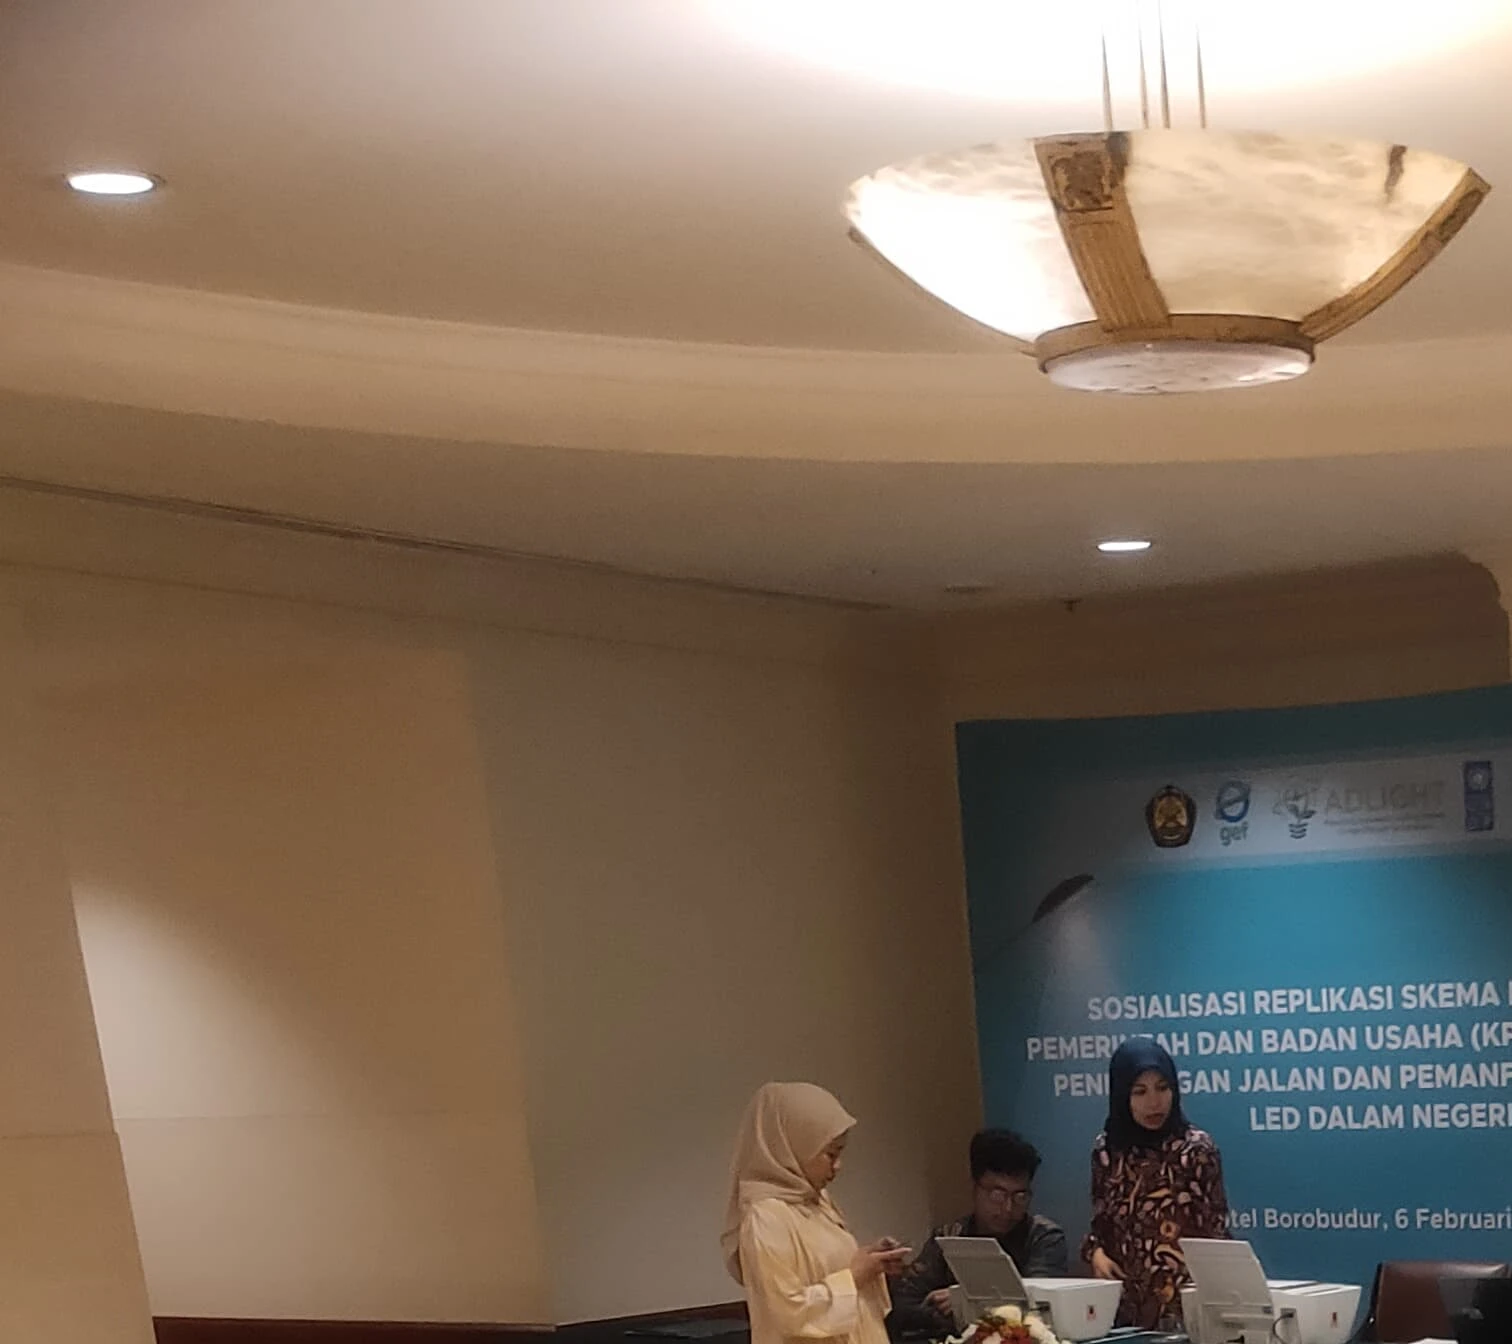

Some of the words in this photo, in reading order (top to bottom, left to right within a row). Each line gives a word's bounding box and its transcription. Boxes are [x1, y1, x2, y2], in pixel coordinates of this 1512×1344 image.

[1220, 823, 1248, 846] gef
[1088, 992, 1246, 1021] SOSIALISASI
[1254, 986, 1393, 1015] REPLIKASI
[1401, 982, 1500, 1009] SKEMA
[1026, 1032, 1189, 1061] PEMERIAH
[1197, 1031, 1253, 1056] DAN
[1261, 1027, 1357, 1054] BADAN
[1366, 1024, 1462, 1050] USAHA
[1238, 1067, 1324, 1092] JALAN
[1333, 1065, 1391, 1091] DAN
[1250, 1106, 1301, 1131] LED
[1309, 1104, 1403, 1130] DALAM
[1225, 1208, 1257, 1229] tel
[1264, 1207, 1388, 1231] Borobudur,
[1395, 1208, 1408, 1229] 6
[1416, 1205, 1512, 1229] Februari
